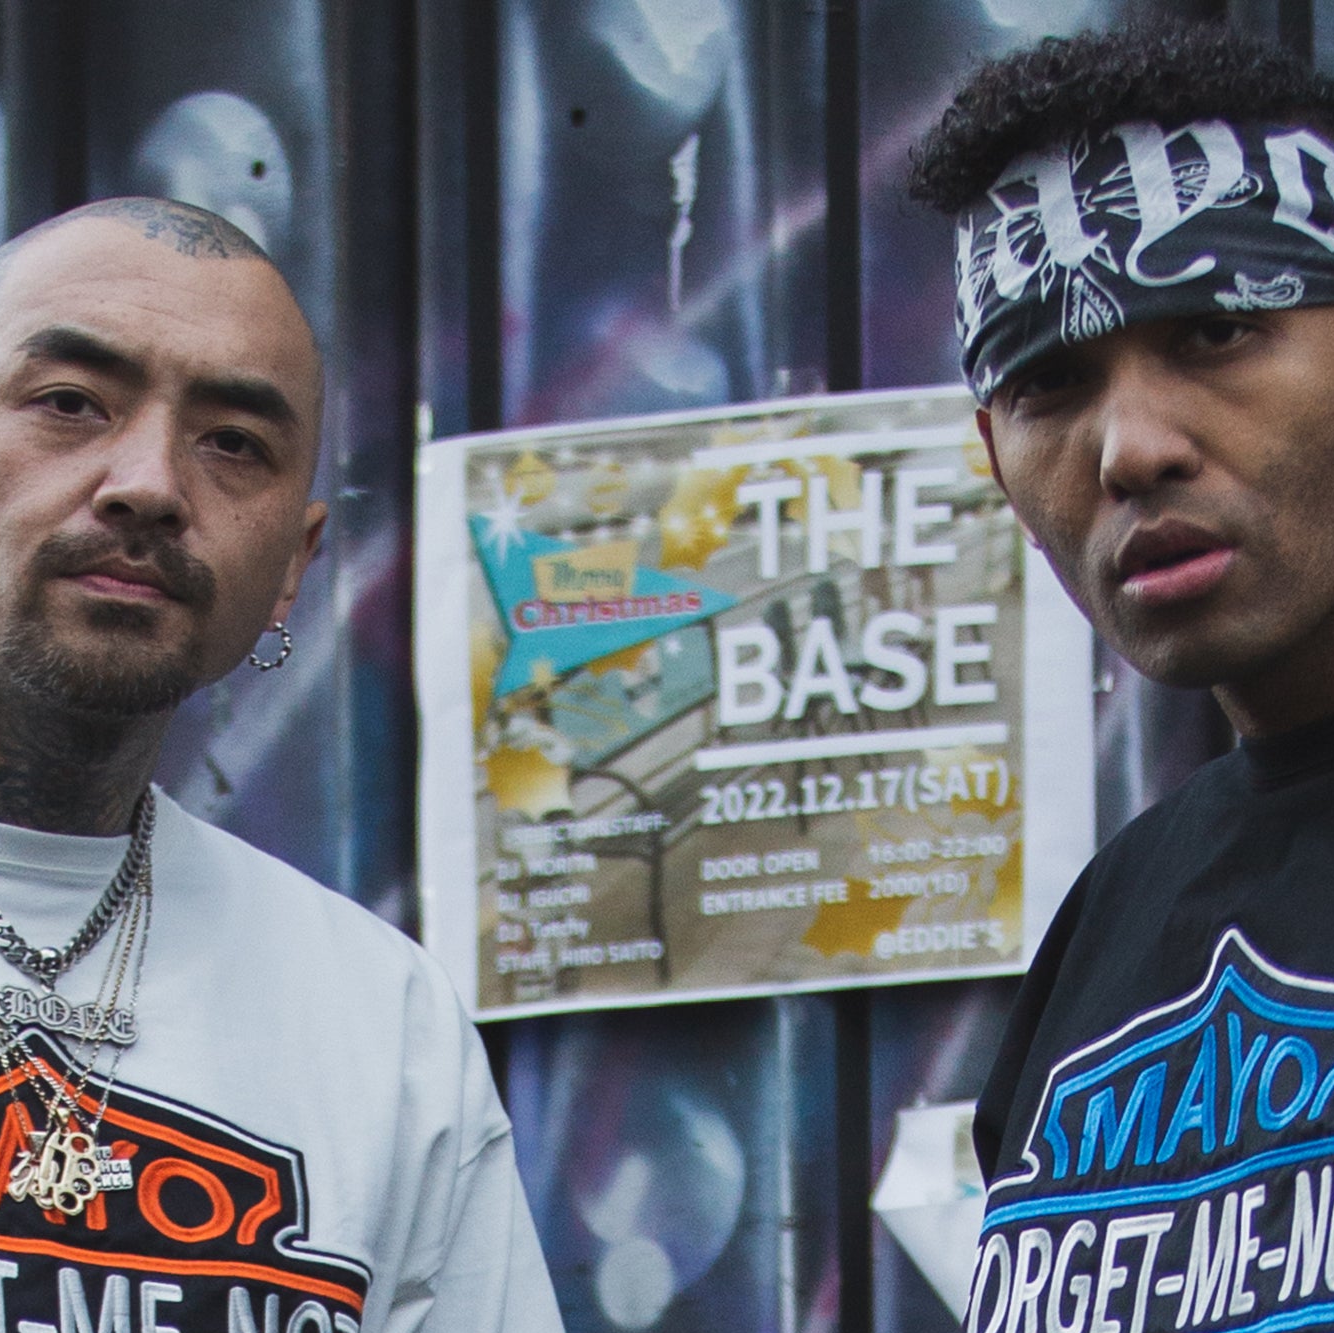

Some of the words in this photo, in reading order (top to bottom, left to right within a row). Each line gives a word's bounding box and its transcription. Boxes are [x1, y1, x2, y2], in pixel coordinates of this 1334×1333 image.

[736, 467, 959, 579] THE
[513, 590, 702, 633] Christmas
[718, 603, 999, 727] BASE
[699, 758, 1010, 825] 2022.12.17(SAT)
[700, 855, 760, 880] DOOR
[765, 849, 820, 874] OPEN
[700, 885, 807, 915] ENTRANCE
[813, 877, 849, 904] FEE
[1077, 1012, 1318, 1175] MAYO
